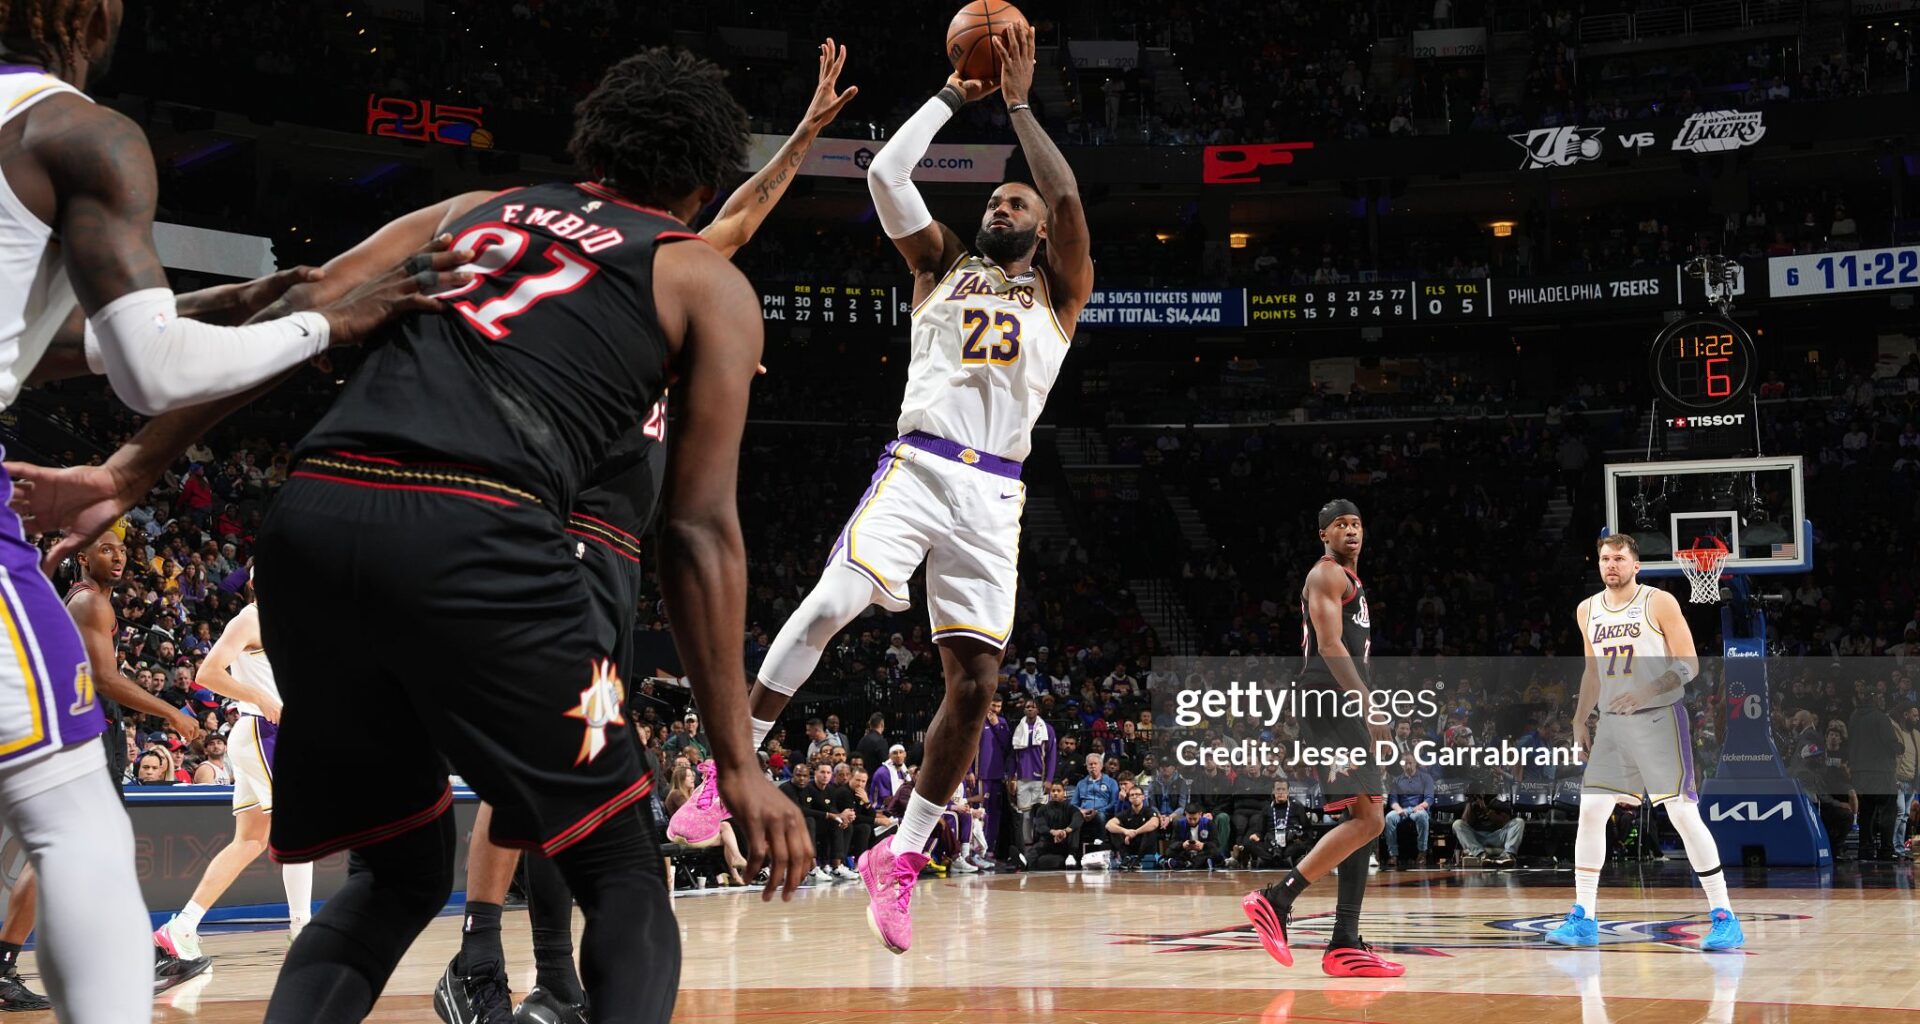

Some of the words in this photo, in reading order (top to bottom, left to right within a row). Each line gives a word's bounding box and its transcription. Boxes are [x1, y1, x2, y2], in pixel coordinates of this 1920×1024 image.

[1416, 47, 1436, 57] 220
[1458, 44, 1484, 56] 219A
[1680, 119, 1759, 147] LAKERS
[755, 169, 787, 203] Fear
[1787, 268, 1799, 286] 6
[1816, 250, 1919, 289] 11:22
[845, 287, 861, 295] BLK
[870, 288, 885, 296] STL
[1108, 291, 1141, 304] 50/50
[1144, 292, 1188, 303] TICKETS
[1192, 291, 1222, 303] NOW!
[1252, 294, 1297, 304] PLAYER
[1305, 293, 1314, 303] 0
[1328, 292, 1336, 302] 8
[1347, 291, 1361, 301] 21
[1368, 290, 1383, 300] 25
[1390, 289, 1406, 300] 77
[1425, 285, 1446, 296] FLS
[1456, 283, 1478, 295] TOL
[1508, 284, 1602, 305] PHILADELPHIA
[1609, 278, 1659, 298] 76ERS
[763, 295, 785, 306] PHI
[795, 296, 811, 307] 30
[824, 297, 832, 308] 8
[849, 298, 857, 309] 2
[874, 300, 882, 310] 3
[1429, 300, 1442, 315] 0
[1462, 299, 1473, 313] 5
[763, 309, 786, 320] LAL
[795, 310, 810, 321] 27
[823, 311, 834, 322] 11
[849, 312, 857, 323] 5
[875, 313, 881, 324] 1
[1118, 308, 1163, 323] TOTAL:
[1166, 306, 1221, 325] $14,440
[1253, 309, 1297, 320] POINTS
[1303, 308, 1317, 319] 15
[1328, 307, 1336, 318] 7
[1350, 306, 1358, 317] 8
[1372, 305, 1380, 316] 4
[1394, 304, 1402, 315] 8
[961, 307, 1021, 367] 23
[1679, 334, 1733, 357] 11:22
[1706, 358, 1731, 397] 6
[1687, 414, 1745, 427] TISSOT
[1592, 622, 1642, 644] LAKERS
[1602, 644, 1635, 678] 77
[1728, 694, 1762, 720] 76
[1722, 753, 1774, 762] ticketmaster
[1709, 800, 1793, 821] KIA
